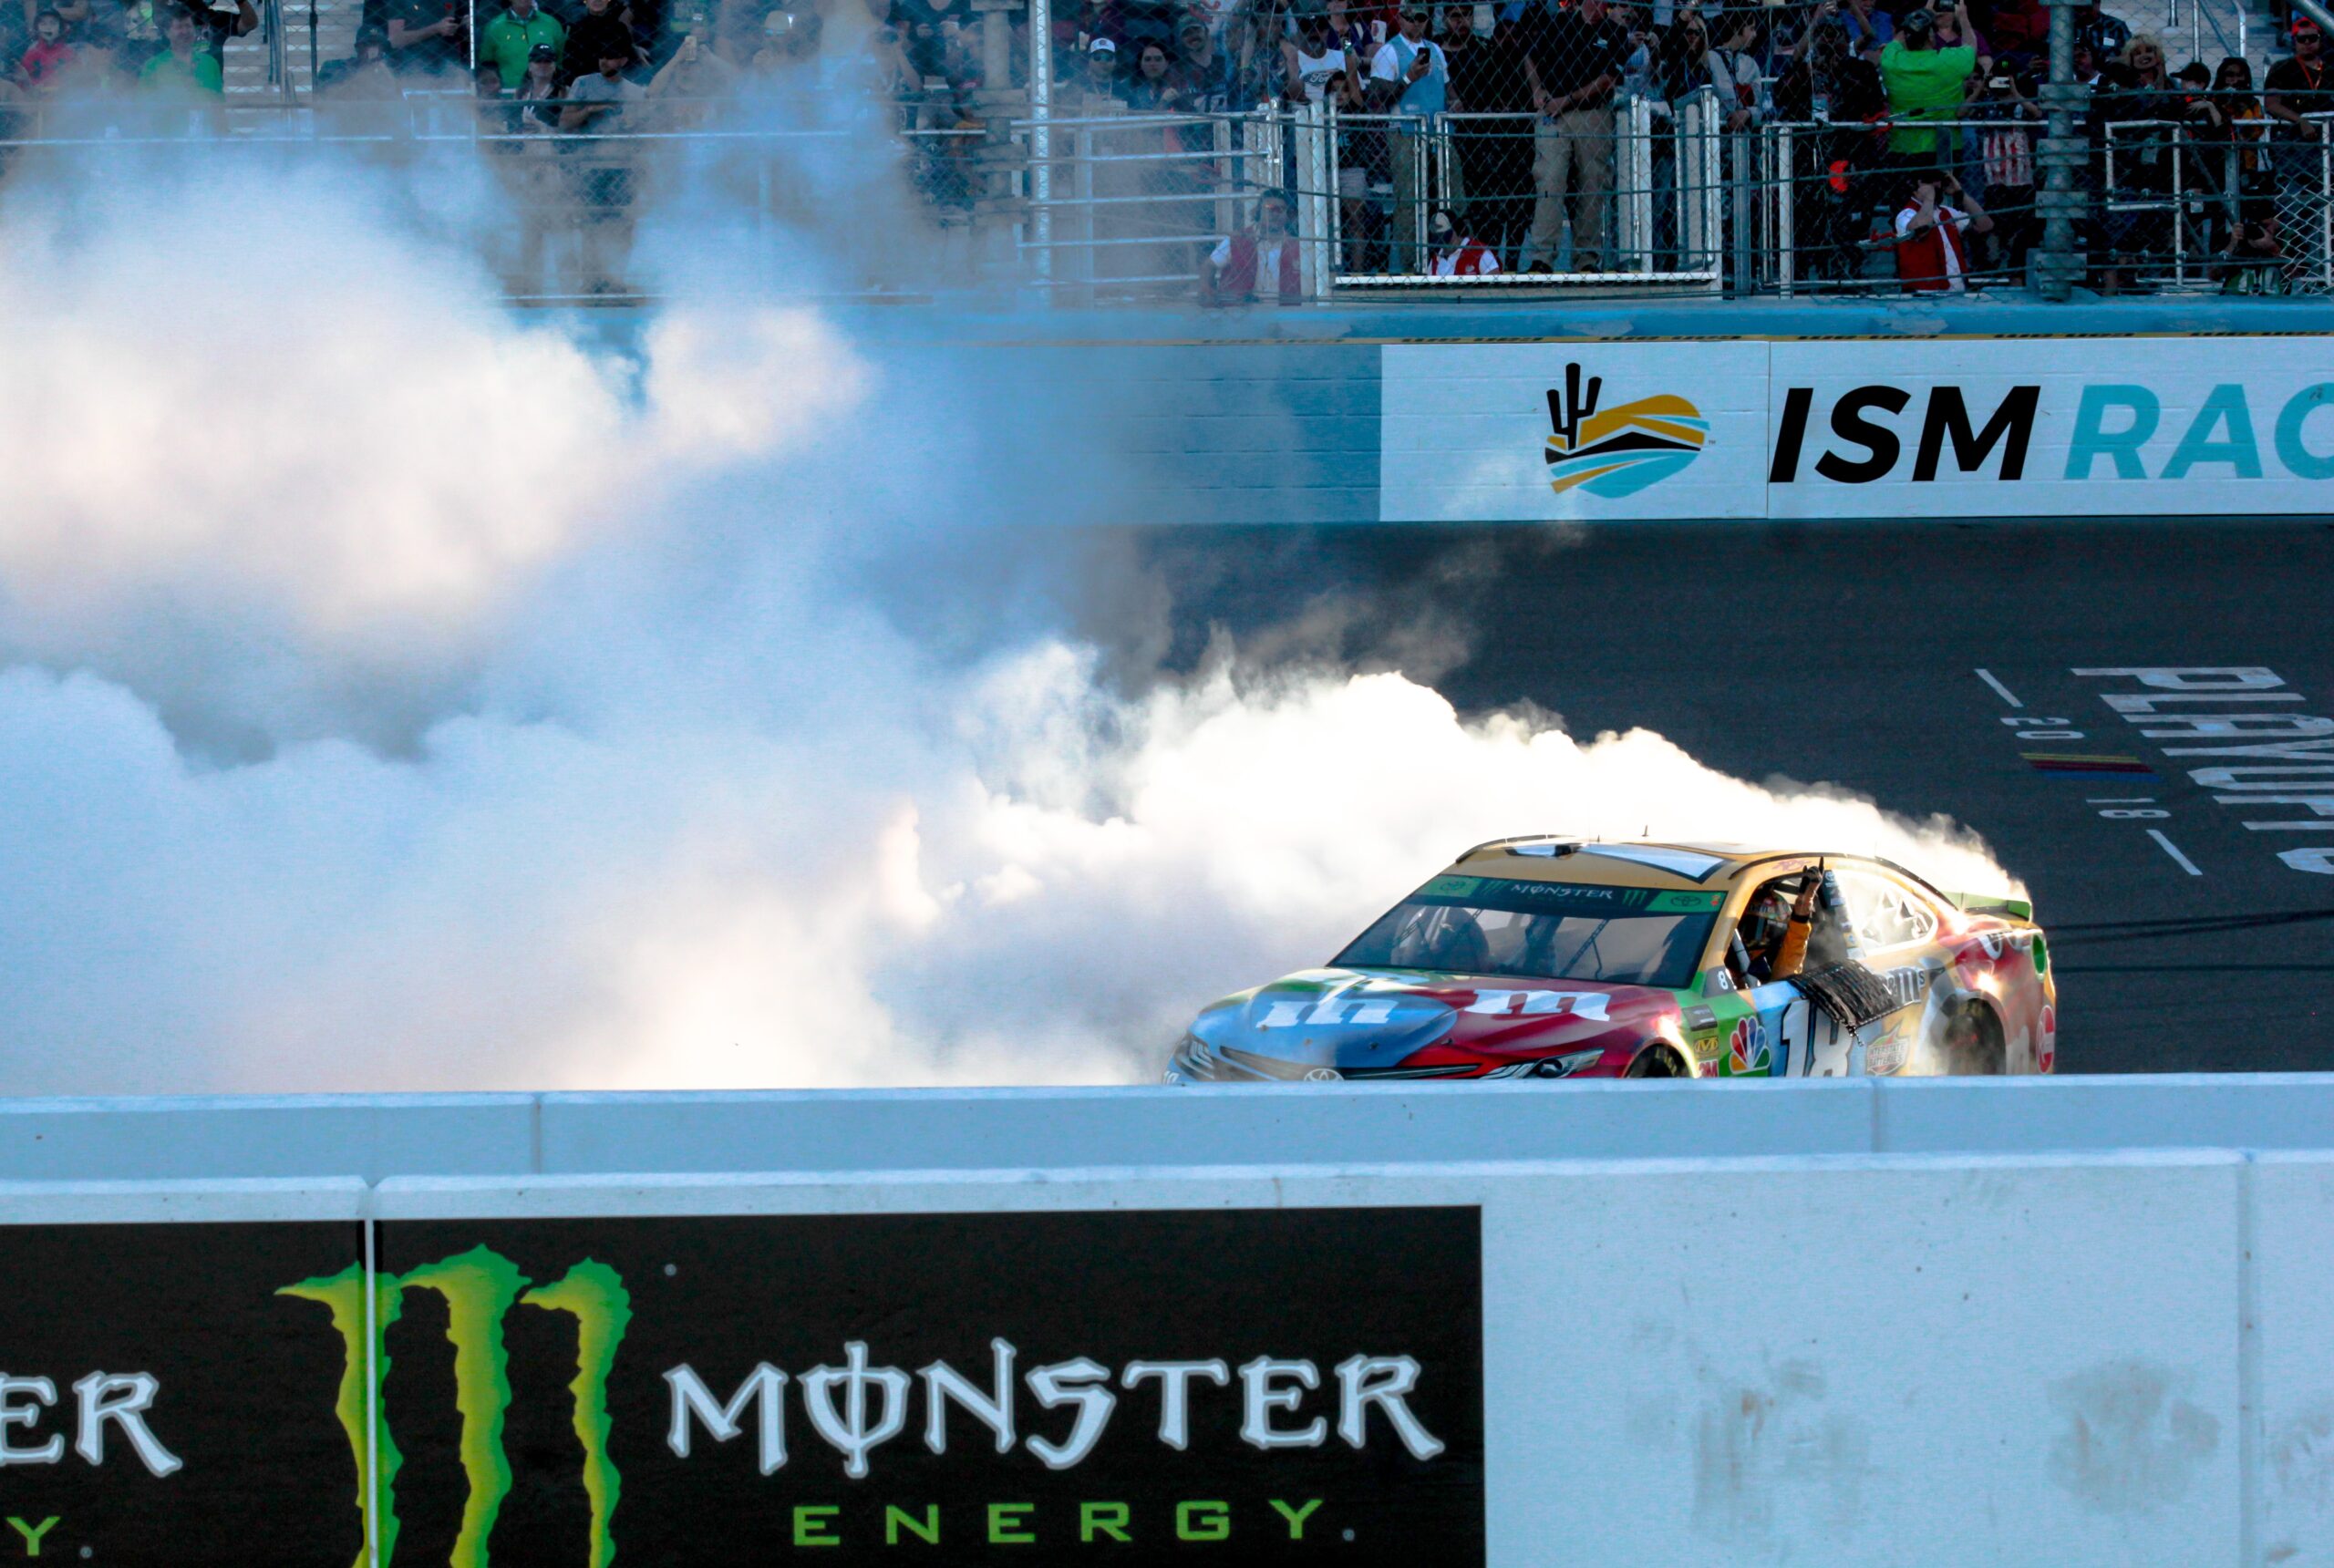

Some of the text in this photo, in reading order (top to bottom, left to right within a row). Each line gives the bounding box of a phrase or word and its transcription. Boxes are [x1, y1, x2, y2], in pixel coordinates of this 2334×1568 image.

[1309, 73, 1331, 83] For
[1769, 385, 2041, 484] ISM
[1999, 717, 2172, 820] 20 18
[1510, 883, 1615, 900] MONSTER
[1717, 970, 1729, 991] 8
[0, 1370, 182, 1478] ER
[662, 1336, 1445, 1479] MONSTER
[6, 1516, 60, 1556] Y
[792, 1499, 1323, 1547] ENERGY
